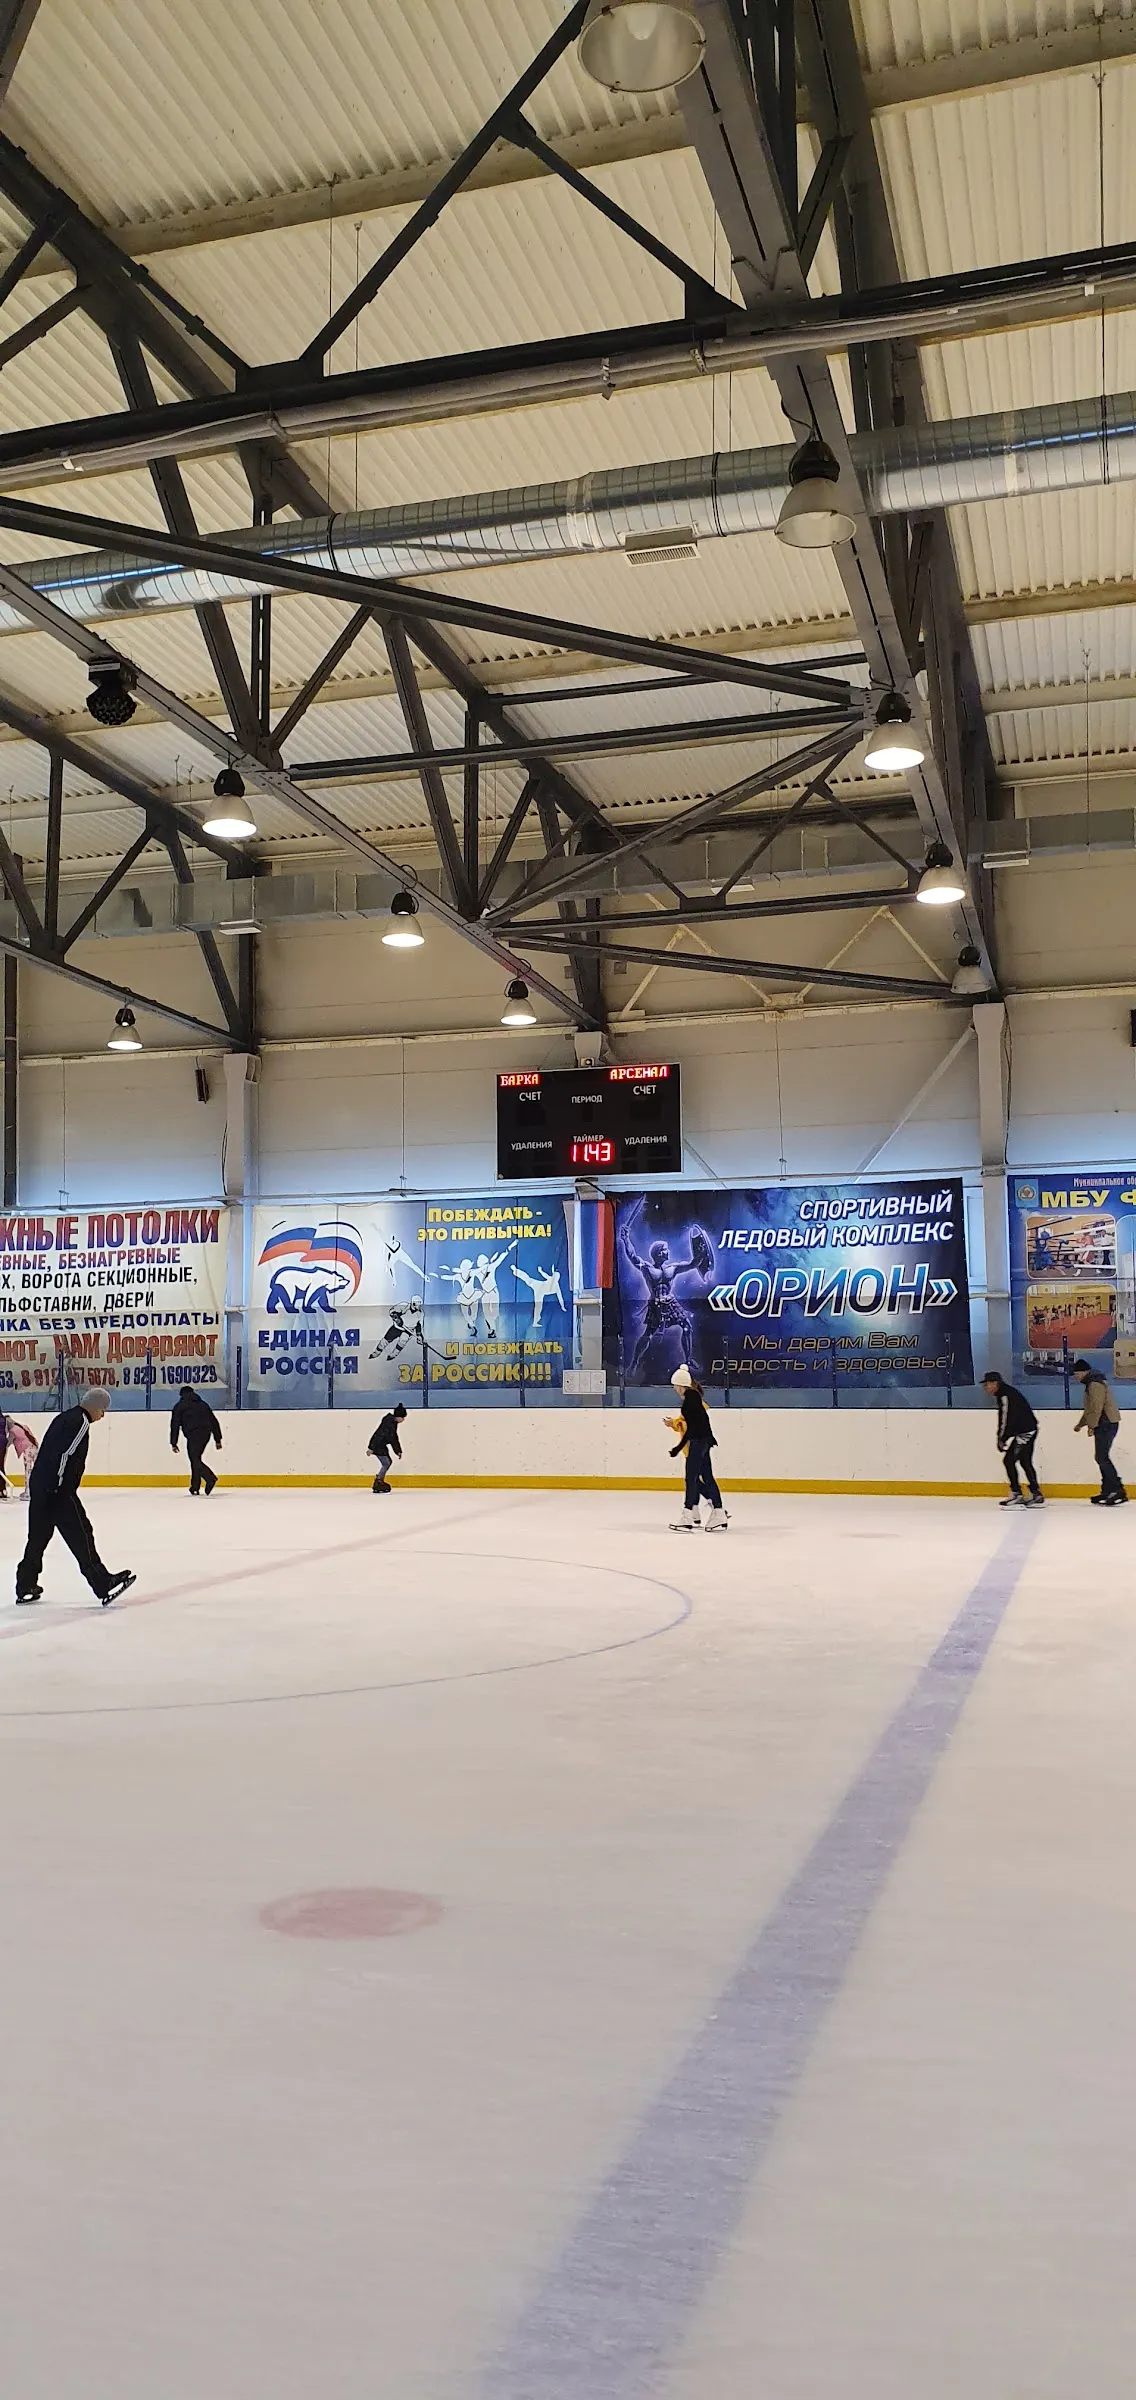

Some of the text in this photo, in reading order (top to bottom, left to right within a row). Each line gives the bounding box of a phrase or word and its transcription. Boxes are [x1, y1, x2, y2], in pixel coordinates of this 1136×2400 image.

[500, 1073, 540, 1087] БАРКА
[610, 1065, 669, 1081] АРСЕНАЛ
[519, 1091, 542, 1102] СЧЕТ
[571, 1095, 603, 1104] ПЕРИОД
[633, 1085, 657, 1096] СЧЕТ
[511, 1141, 553, 1151] УДАЛЕНИЯ
[573, 1134, 605, 1143] ТАЙМЕР
[624, 1136, 668, 1146] УДАЛЕНИЯ
[799, 1190, 954, 1220] СПОРТИВНЫЙ
[1041, 1189, 1110, 1208] МБУ
[88, 1210, 220, 1248] ПОТОЛКИ
[417, 1224, 552, 1241] ЭТО ПРИВЫЧКА!
[718, 1221, 955, 1252] ЛЕДОВЫЙ КОМПЛЕКС
[58, 1247, 181, 1270] БЕЗНАГРЕВНЫЕ
[21, 1273, 82, 1289] ВОРОТА
[87, 1267, 198, 1287] СЕКЦИОННЫЕ,
[708, 1262, 959, 1319] «ОРИОН»
[104, 1291, 155, 1312] ДВЕРИ
[39, 1317, 76, 1330] БЕЗ
[84, 1312, 220, 1330] ПРЕДОПЛАТЫ
[258, 1329, 360, 1351] ЕДИНАЯ
[446, 1341, 564, 1356] И ПОБЕЖДАТЬ
[742, 1331, 919, 1352] Мы дарим Вам
[260, 1356, 359, 1375] РОССИЯ
[710, 1352, 956, 1374] радость и здоровье!
[20, 1369, 31, 1387] 8
[122, 1366, 131, 1385] 8
[160, 1364, 218, 1385] 1690329
[398, 1364, 424, 1383] ЗА
